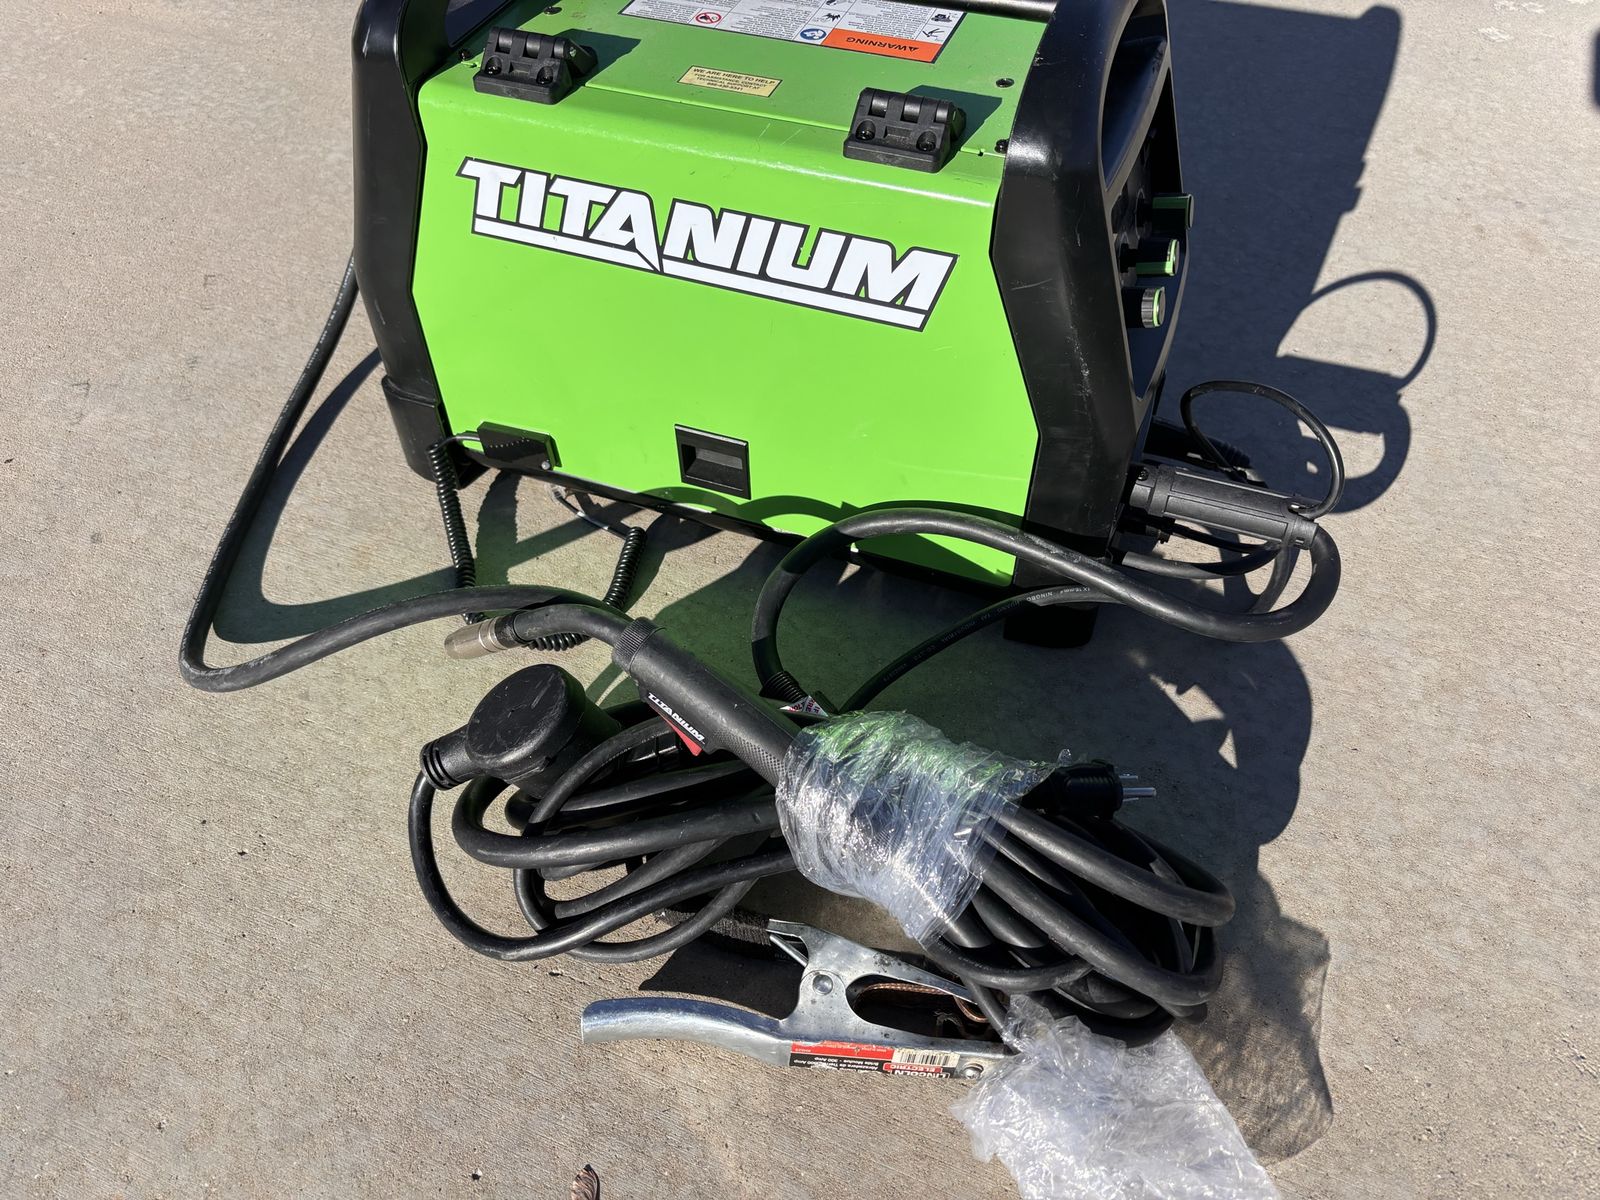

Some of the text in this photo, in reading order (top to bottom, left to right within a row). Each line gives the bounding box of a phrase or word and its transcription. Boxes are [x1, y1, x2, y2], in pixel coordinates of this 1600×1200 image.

[846, 37, 907, 51] WARNING
[457, 157, 959, 322] TITANIUM
[1026, 592, 1053, 601] NINGBO
[648, 692, 705, 741] TITANIUM
[890, 1064, 935, 1072] ELECTRIC
[894, 1070, 946, 1078] LINCOLN
